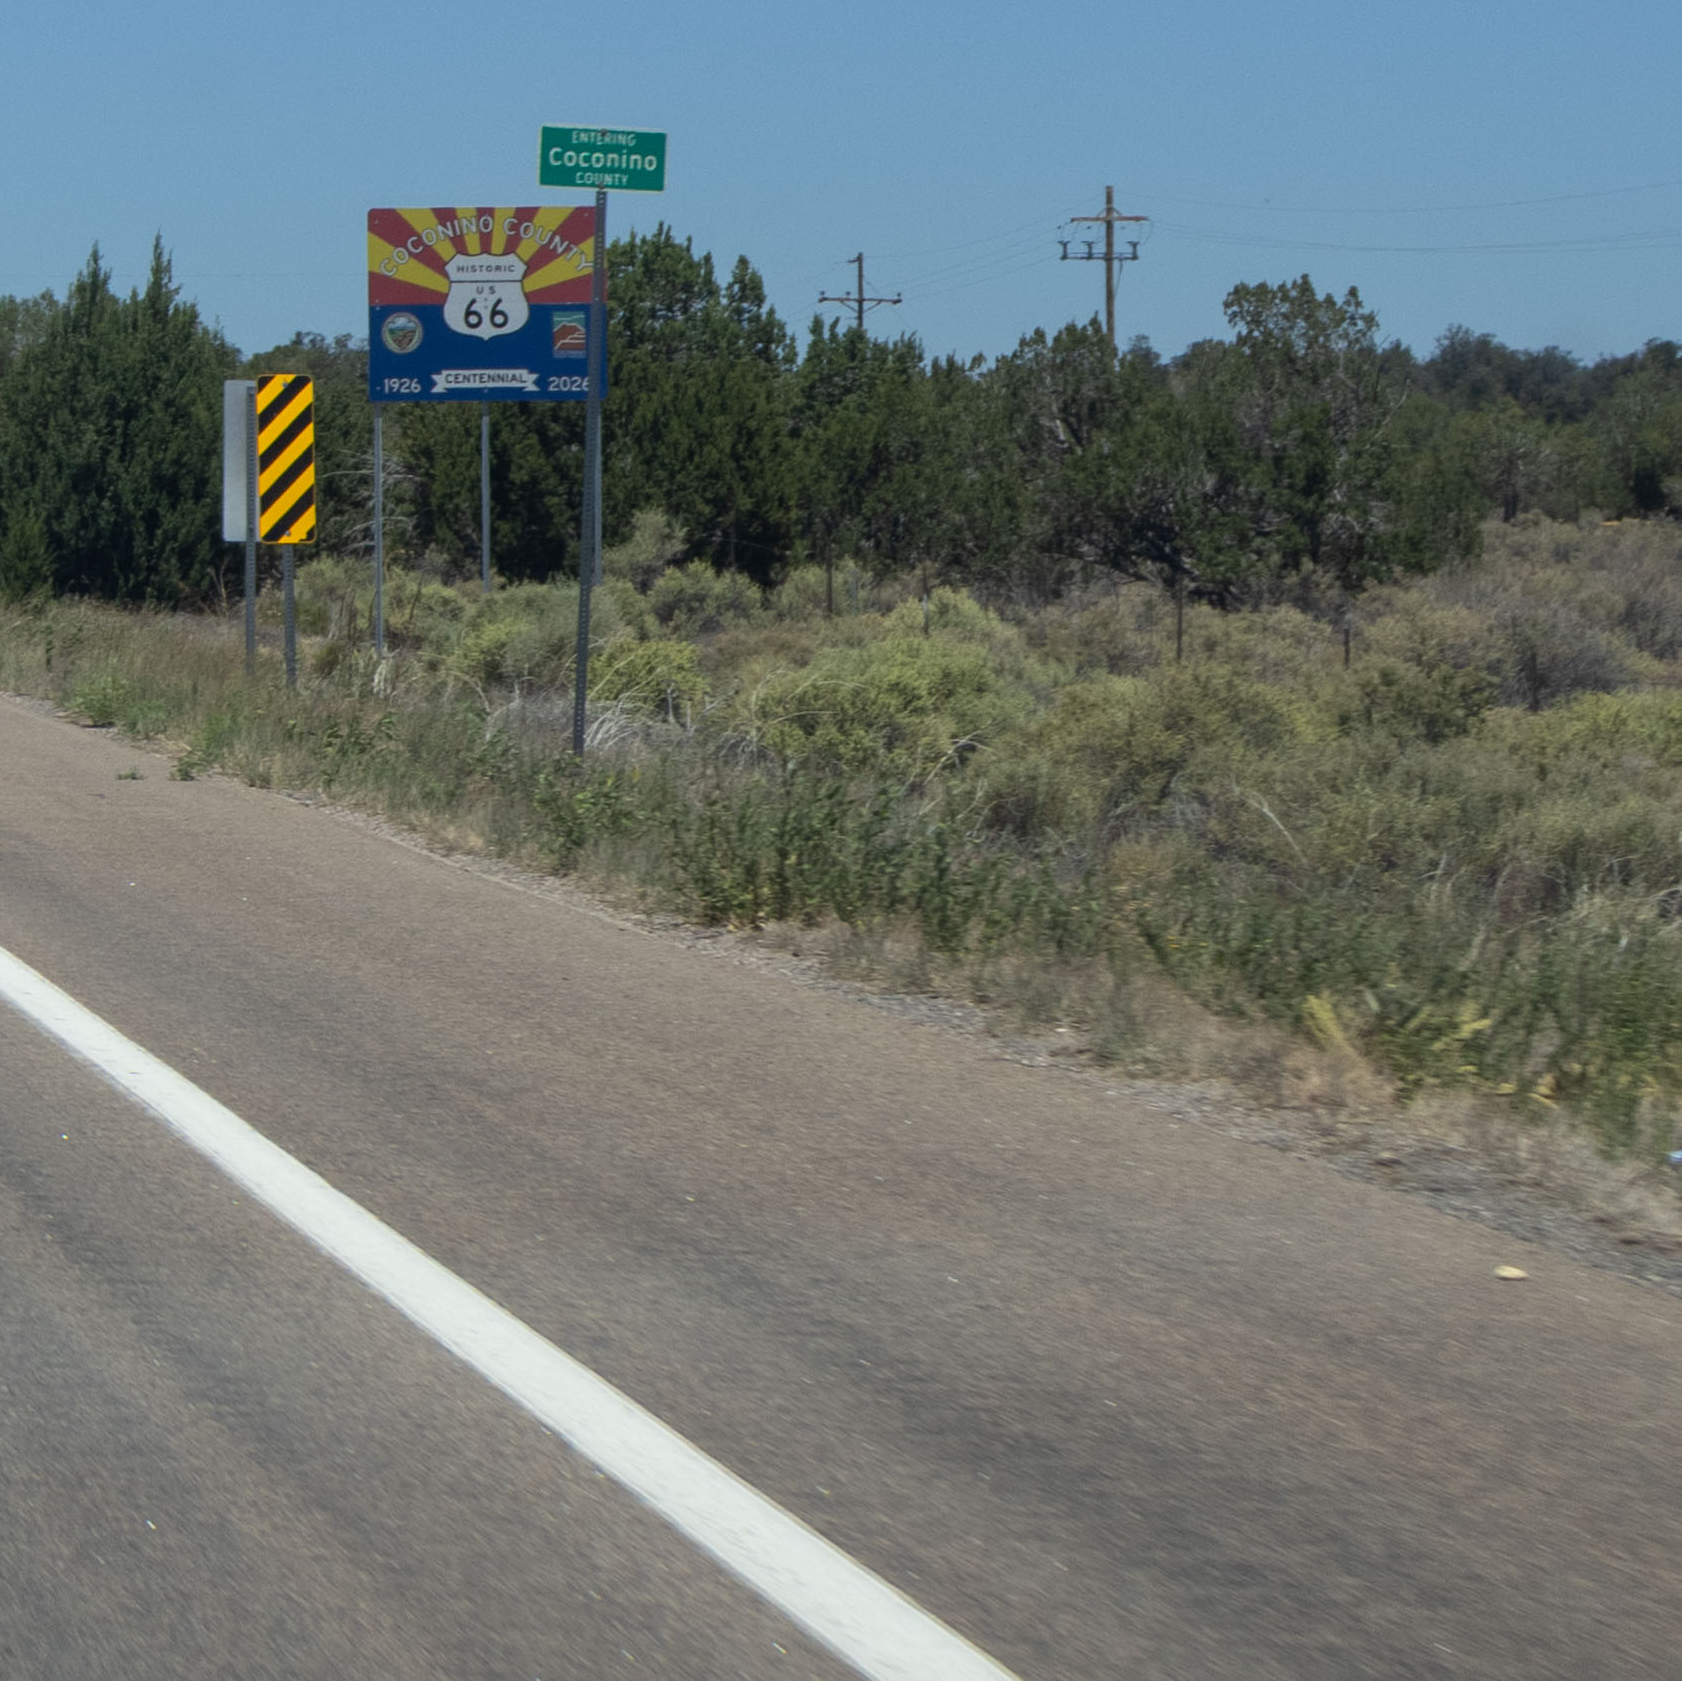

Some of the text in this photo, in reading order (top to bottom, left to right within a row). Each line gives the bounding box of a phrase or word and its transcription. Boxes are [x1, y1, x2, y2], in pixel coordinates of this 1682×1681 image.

[572, 129, 636, 146] ENTERING
[548, 147, 657, 171] Coconino
[575, 171, 629, 186] COUNTY
[379, 215, 595, 277] COCONINO COUNTY
[456, 264, 516, 273] HISTORIC
[464, 297, 509, 329] 66
[384, 378, 421, 393] 1926
[445, 373, 528, 385] CENTENNIAL
